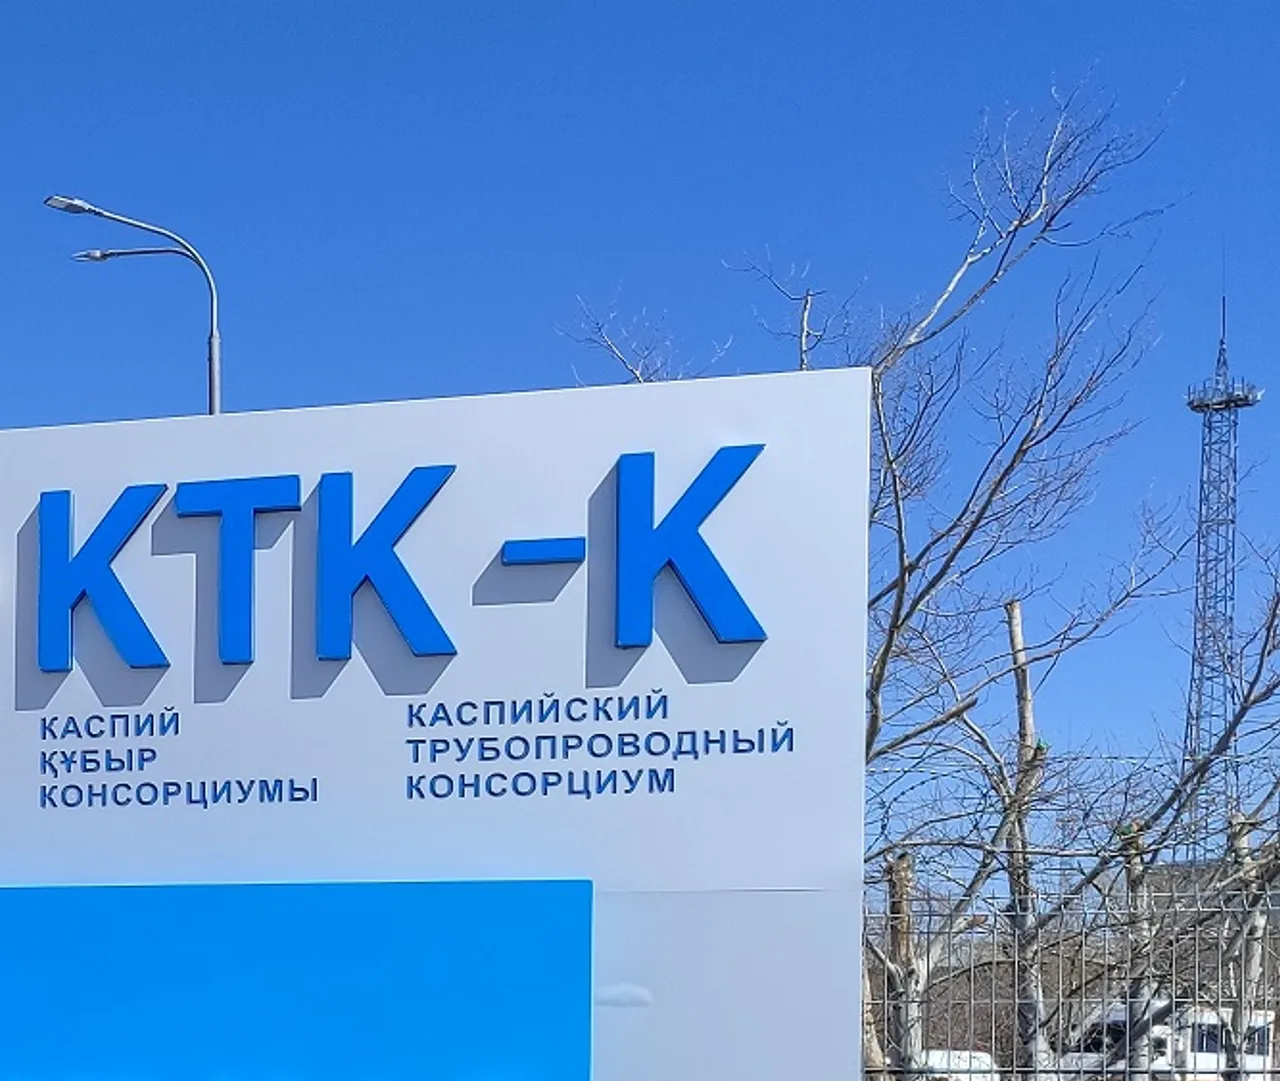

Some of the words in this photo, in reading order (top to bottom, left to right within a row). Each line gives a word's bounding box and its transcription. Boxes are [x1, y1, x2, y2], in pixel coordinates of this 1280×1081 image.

[40, 706, 180, 740] КАСПИЙ
[407, 688, 670, 728] КАСПИЙСКИЙ
[406, 720, 796, 764] ТРУБОПРОВОДНЫЙ
[40, 748, 158, 779] ҚҰБЫР
[40, 777, 318, 809] КОНСОРЦИУМЫ
[406, 767, 676, 800] КОНСОРЦИУМ
